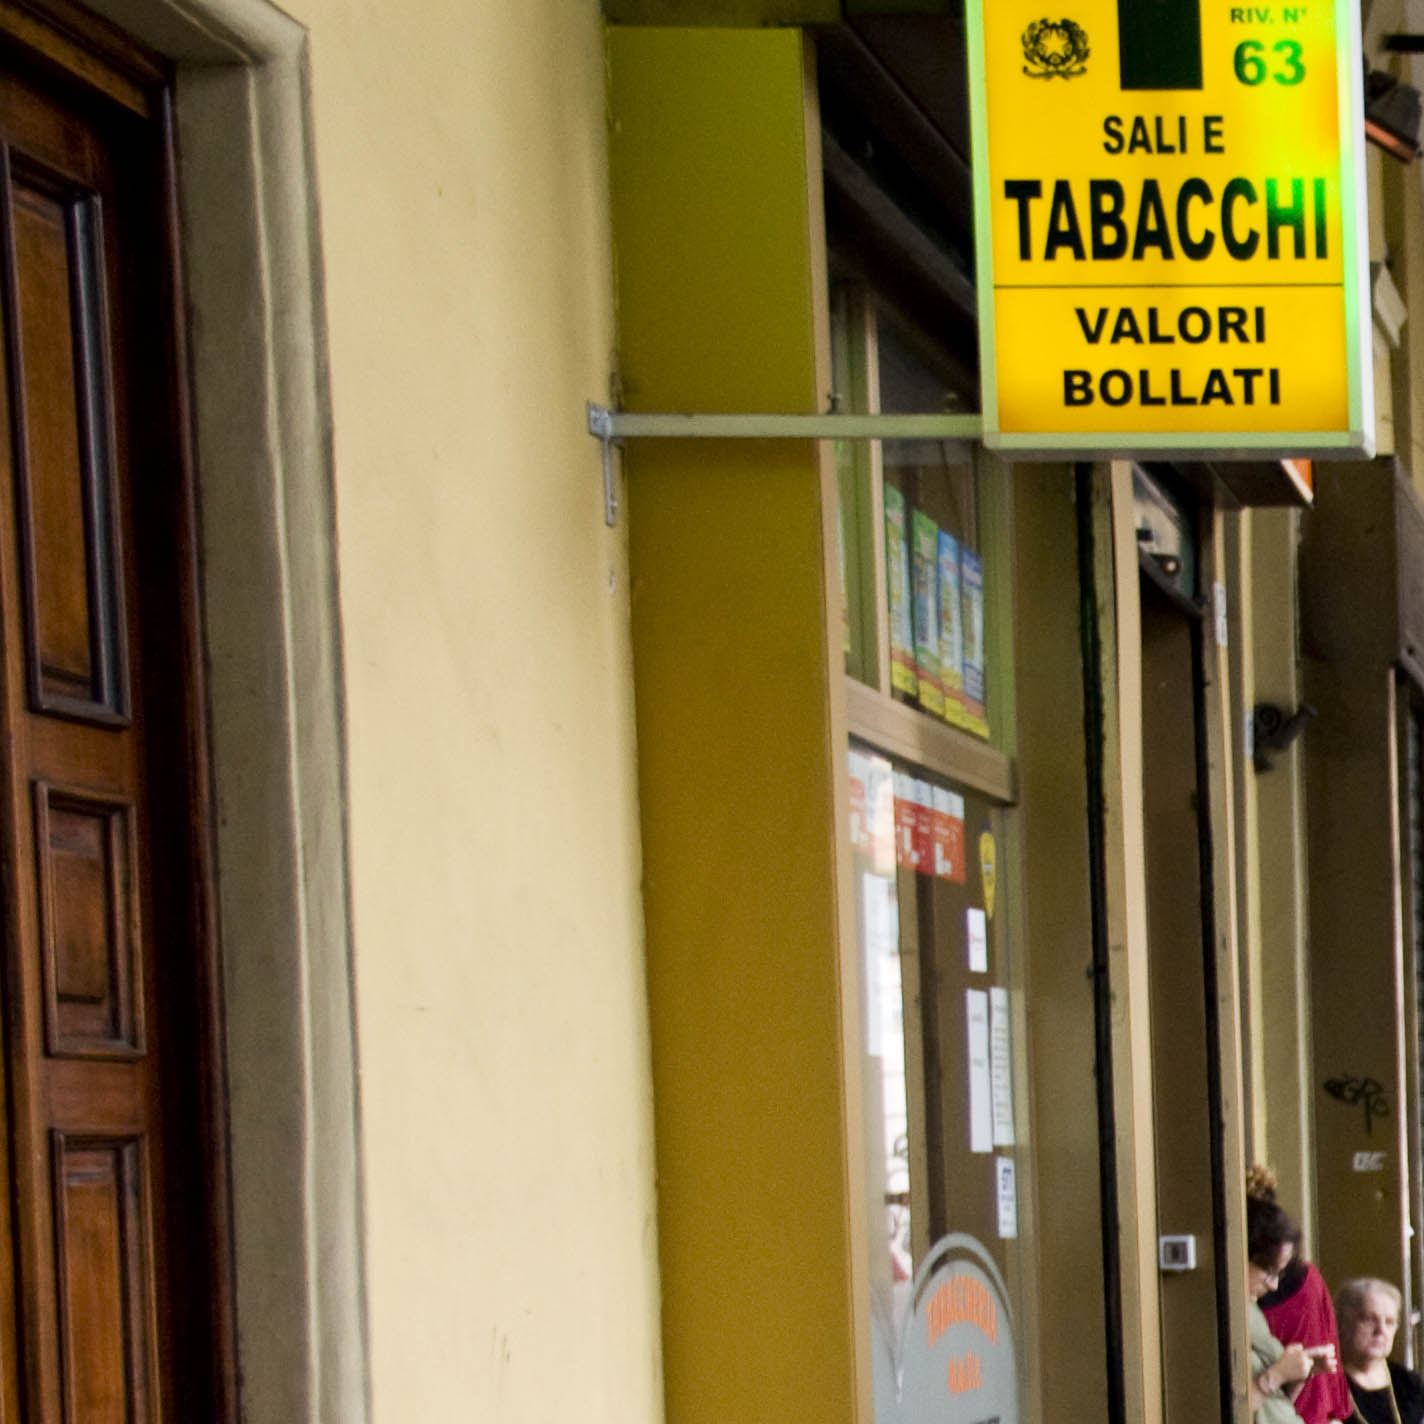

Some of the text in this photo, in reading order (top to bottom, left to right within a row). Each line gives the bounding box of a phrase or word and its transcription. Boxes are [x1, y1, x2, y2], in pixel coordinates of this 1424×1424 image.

[1230, 7, 1274, 24] RIV.
[1233, 39, 1306, 87] 63
[1102, 115, 1225, 155] SALI E
[1004, 177, 1329, 262] TABACCHI
[1075, 306, 1266, 345] VALORI
[1062, 368, 1281, 407] BOLLATI
